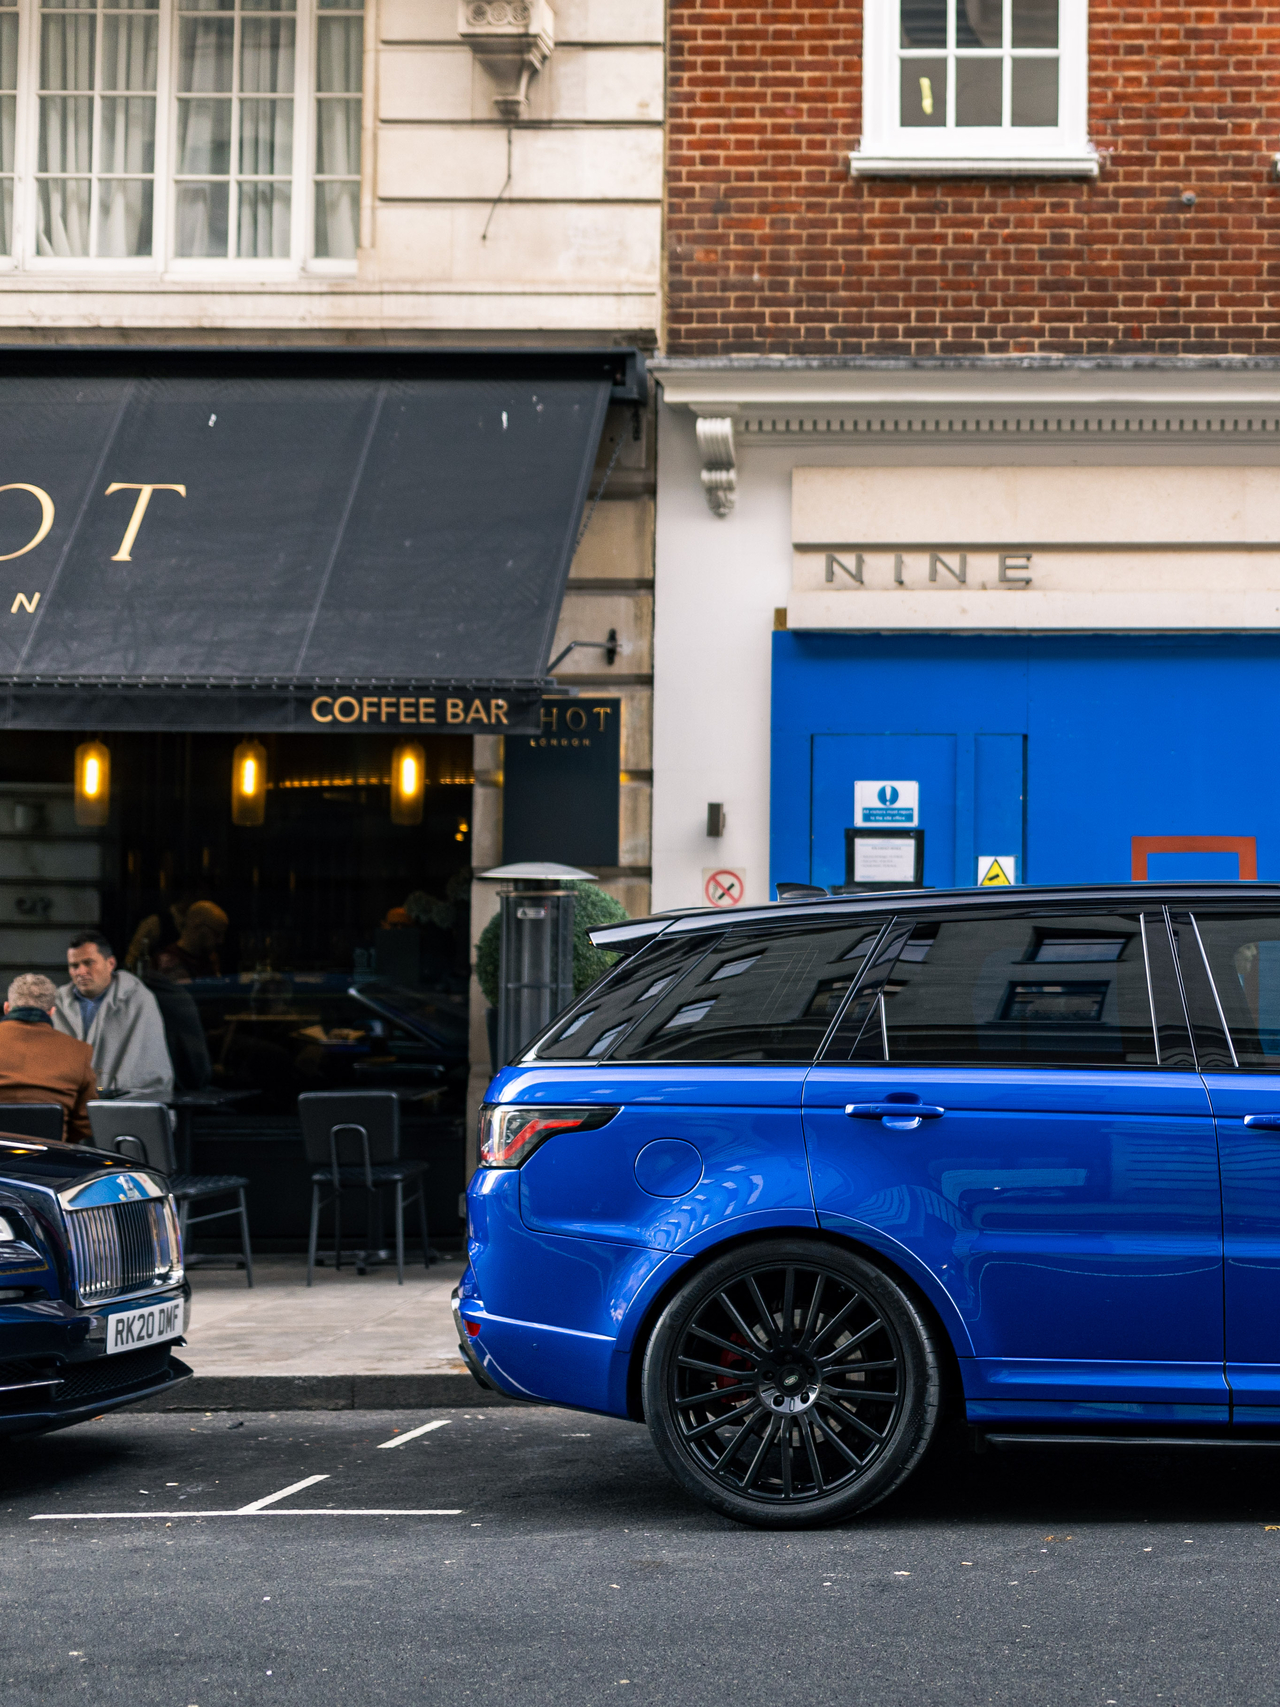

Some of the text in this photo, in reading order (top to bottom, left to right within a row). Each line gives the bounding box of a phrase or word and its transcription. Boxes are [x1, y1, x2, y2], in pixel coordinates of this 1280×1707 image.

[825, 553, 1033, 585] NINE
[311, 695, 509, 725] COFFEE BAR
[540, 707, 611, 732] HOT
[530, 738, 591, 747] LONDON
[114, 1304, 179, 1347] RK20 DMF
